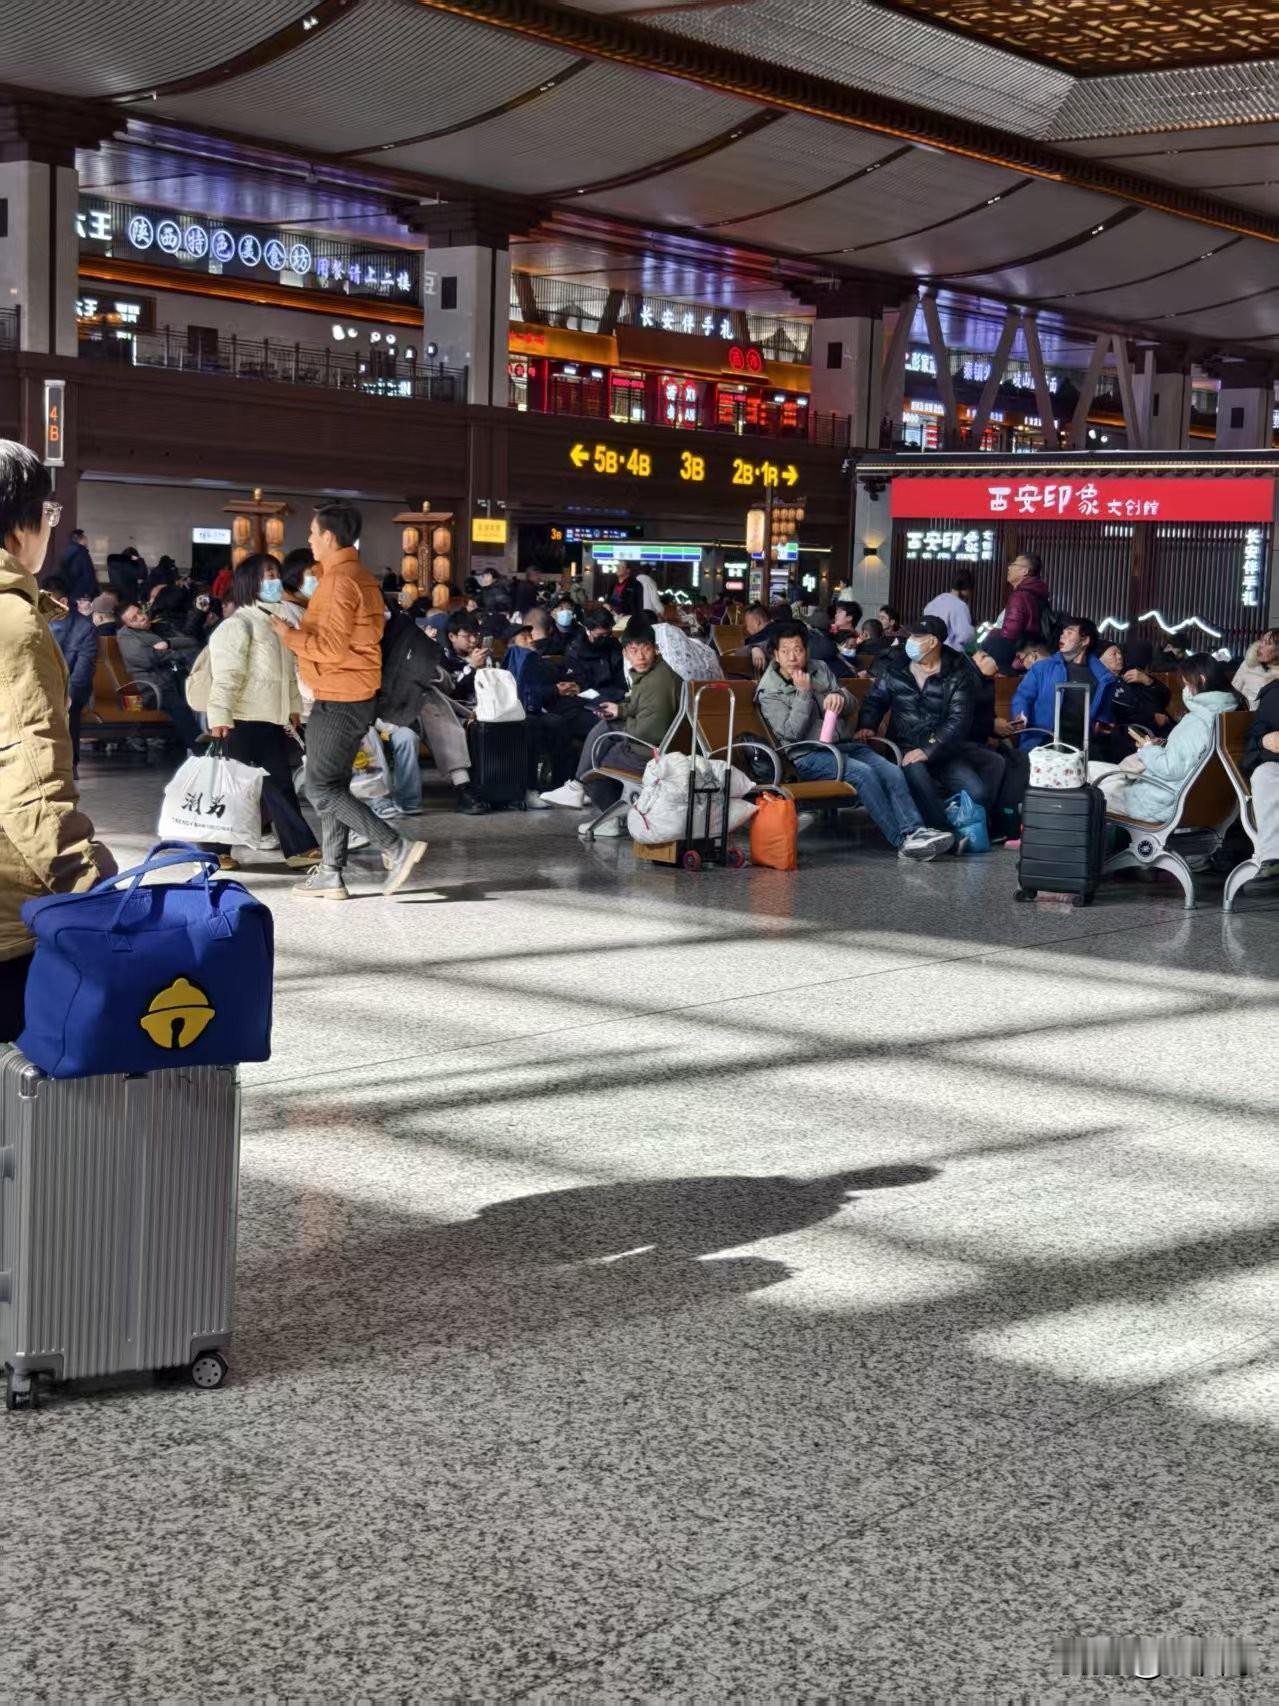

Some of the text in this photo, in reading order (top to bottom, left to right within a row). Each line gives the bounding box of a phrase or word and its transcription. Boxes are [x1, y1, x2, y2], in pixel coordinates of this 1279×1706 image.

[129, 217, 311, 275] 陕西特色美食坊
[317, 257, 411, 292] 用餐请上二楼
[640, 304, 734, 340] 长安伴手礼
[50, 405, 59, 441] 4B
[680, 451, 705, 481] 3B
[988, 483, 1100, 515] 西安印象
[1241, 528, 1261, 607] 长安伴手礼
